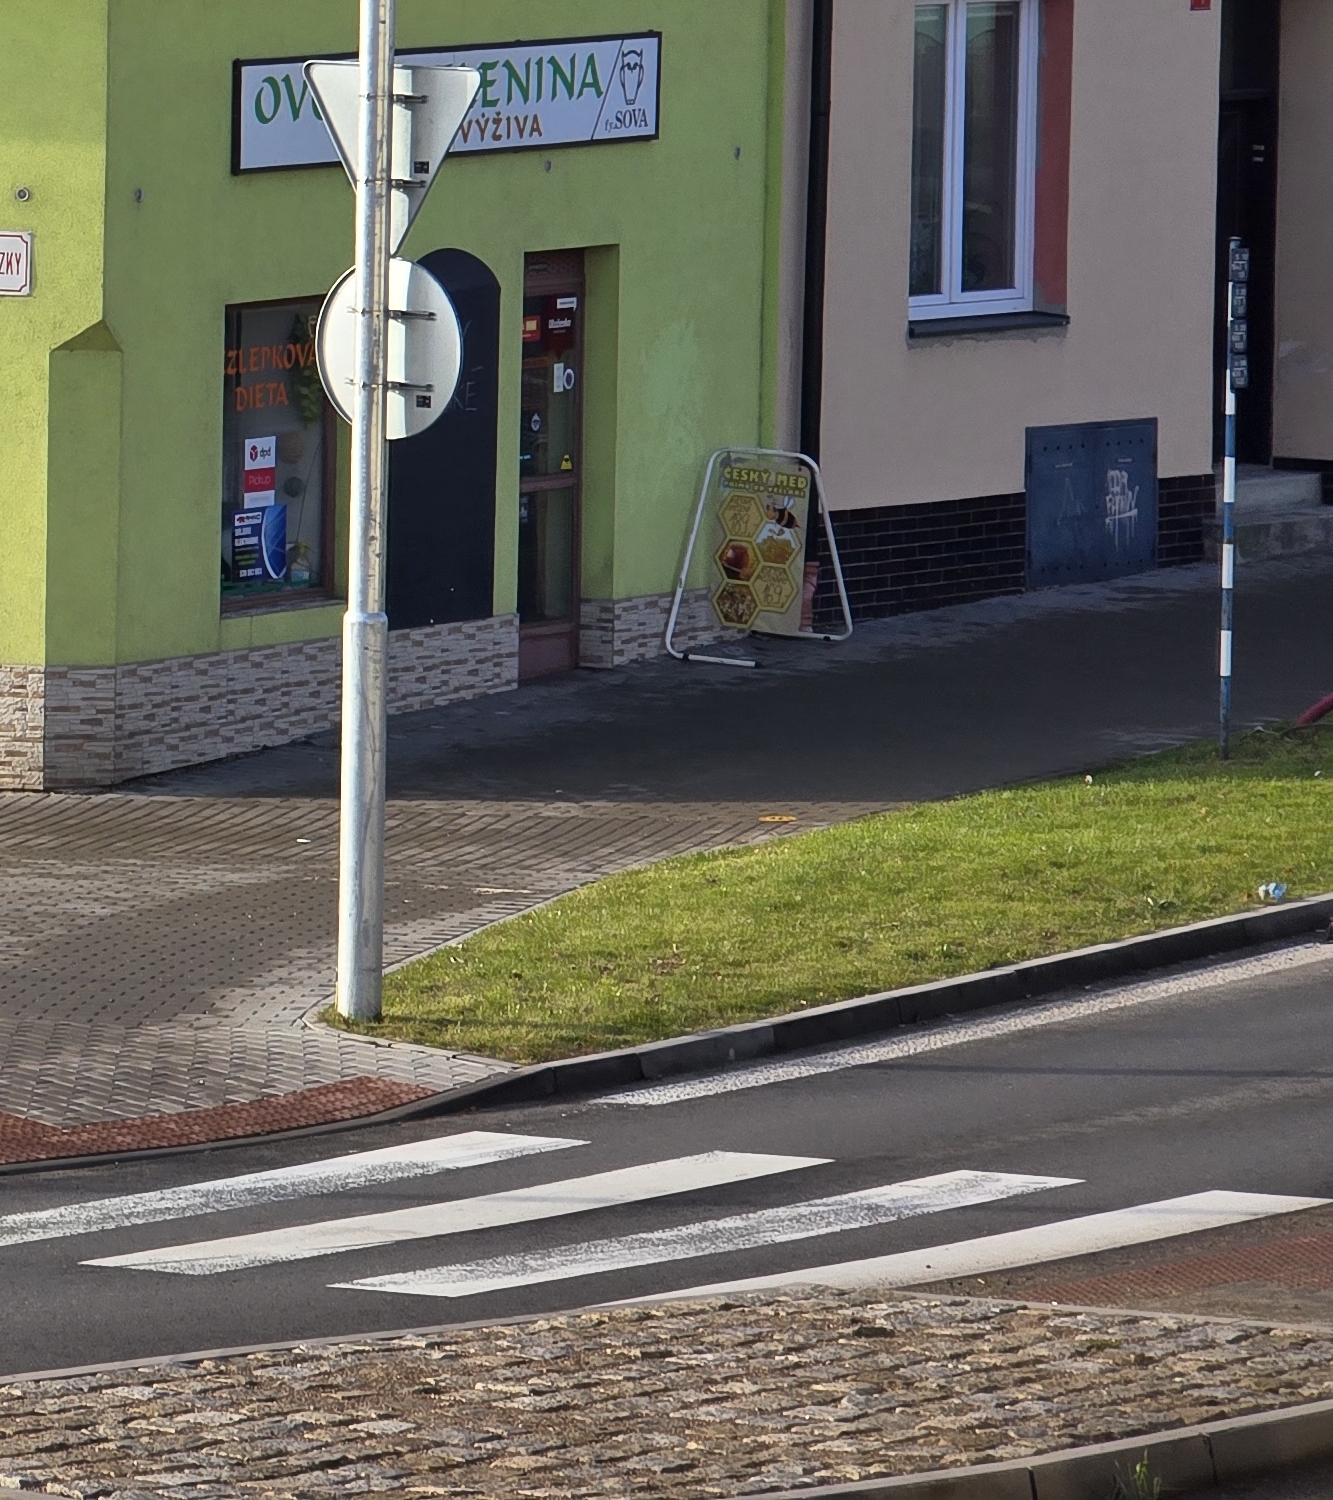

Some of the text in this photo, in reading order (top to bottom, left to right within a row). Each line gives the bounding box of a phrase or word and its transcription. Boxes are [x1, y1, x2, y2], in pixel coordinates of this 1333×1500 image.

[235, 381, 290, 412] DIETA
[259, 446, 272, 460] dpd
[776, 472, 808, 490] MED
